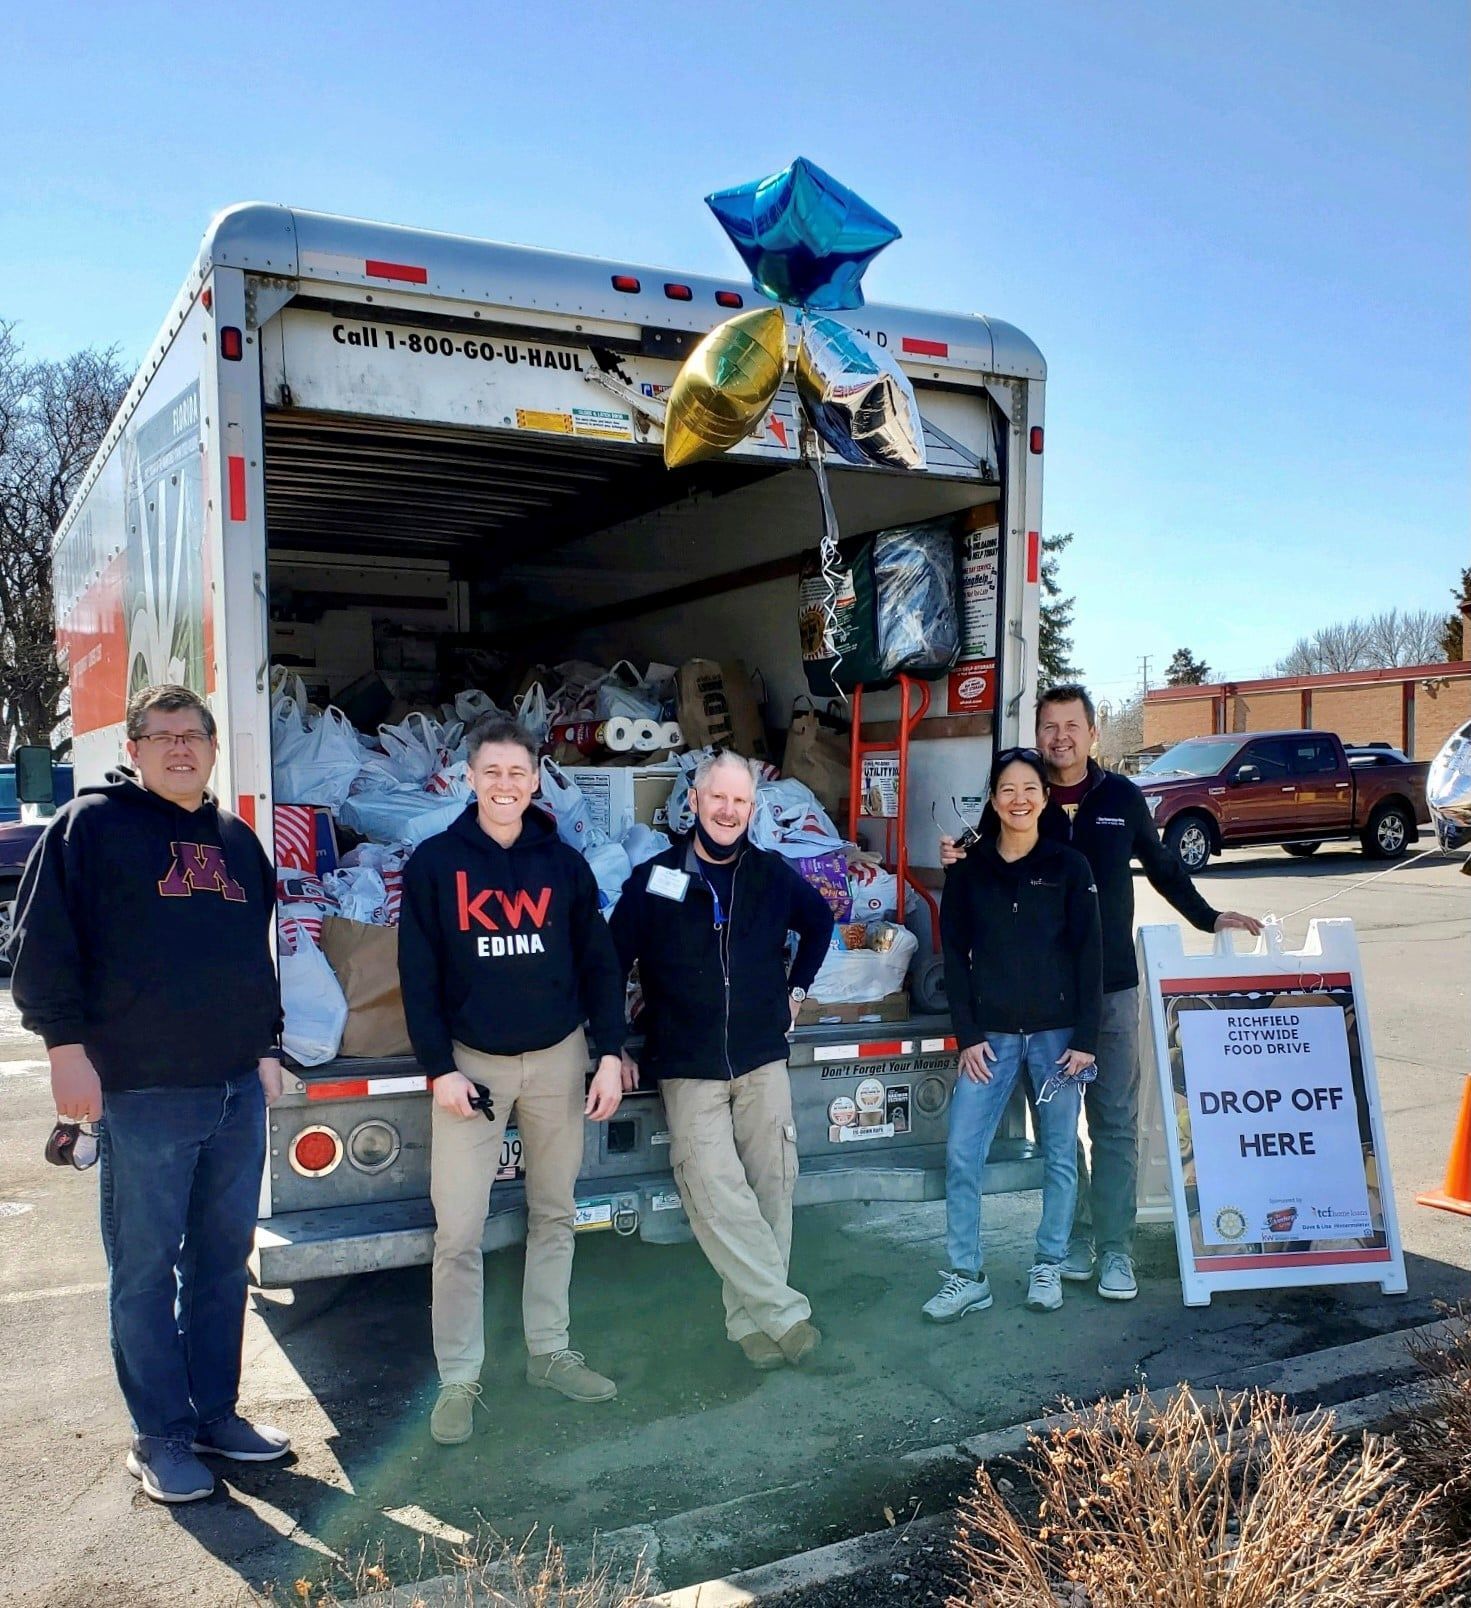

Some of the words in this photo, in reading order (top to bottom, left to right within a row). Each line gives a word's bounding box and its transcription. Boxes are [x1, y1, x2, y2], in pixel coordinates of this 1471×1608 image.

[332, 324, 378, 347] Call
[385, 330, 584, 373] 1-800-GO-U-HAUL
[877, 331, 887, 348] D
[173, 392, 199, 436] FLORIDA
[864, 767, 893, 777] UTILITY
[158, 841, 248, 903] M
[477, 933, 545, 957] EDINA
[1227, 1015, 1300, 1028] RICHFIELD
[1228, 1028, 1300, 1041] CITYWIDE
[1224, 1044, 1263, 1056] FOOD
[1267, 1042, 1311, 1055] DRIVE
[821, 1065, 850, 1079] Don't
[853, 1062, 886, 1076] Forget
[889, 1061, 911, 1072] Your
[914, 1058, 950, 1070] Moving
[1200, 1089, 1283, 1115] DROP
[1291, 1087, 1344, 1112] OFF
[1239, 1131, 1316, 1158] HERE
[1317, 1206, 1332, 1218] tcf
